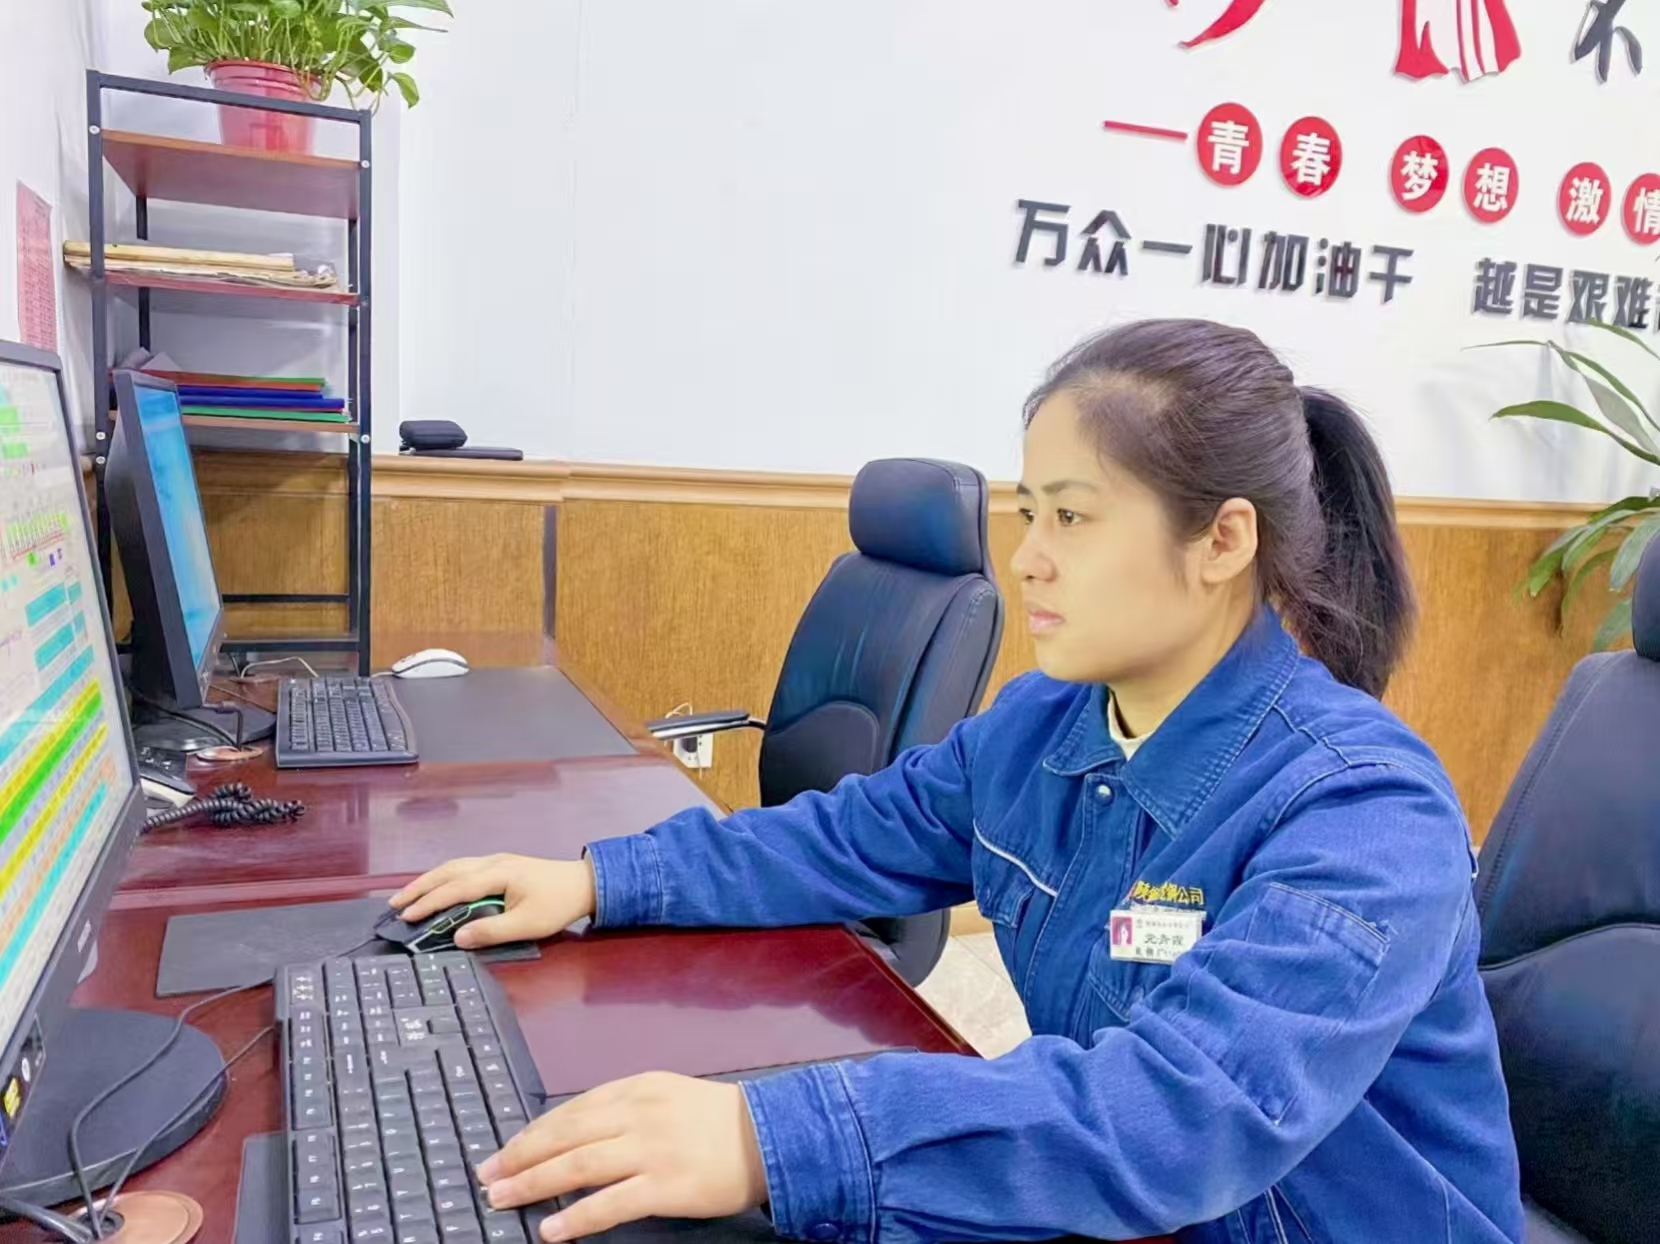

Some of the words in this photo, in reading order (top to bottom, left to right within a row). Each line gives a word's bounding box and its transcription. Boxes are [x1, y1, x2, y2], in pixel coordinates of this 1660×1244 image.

[1016, 199, 1415, 304] 万众一心加油干
[1473, 257, 1660, 332] 越是艰难
